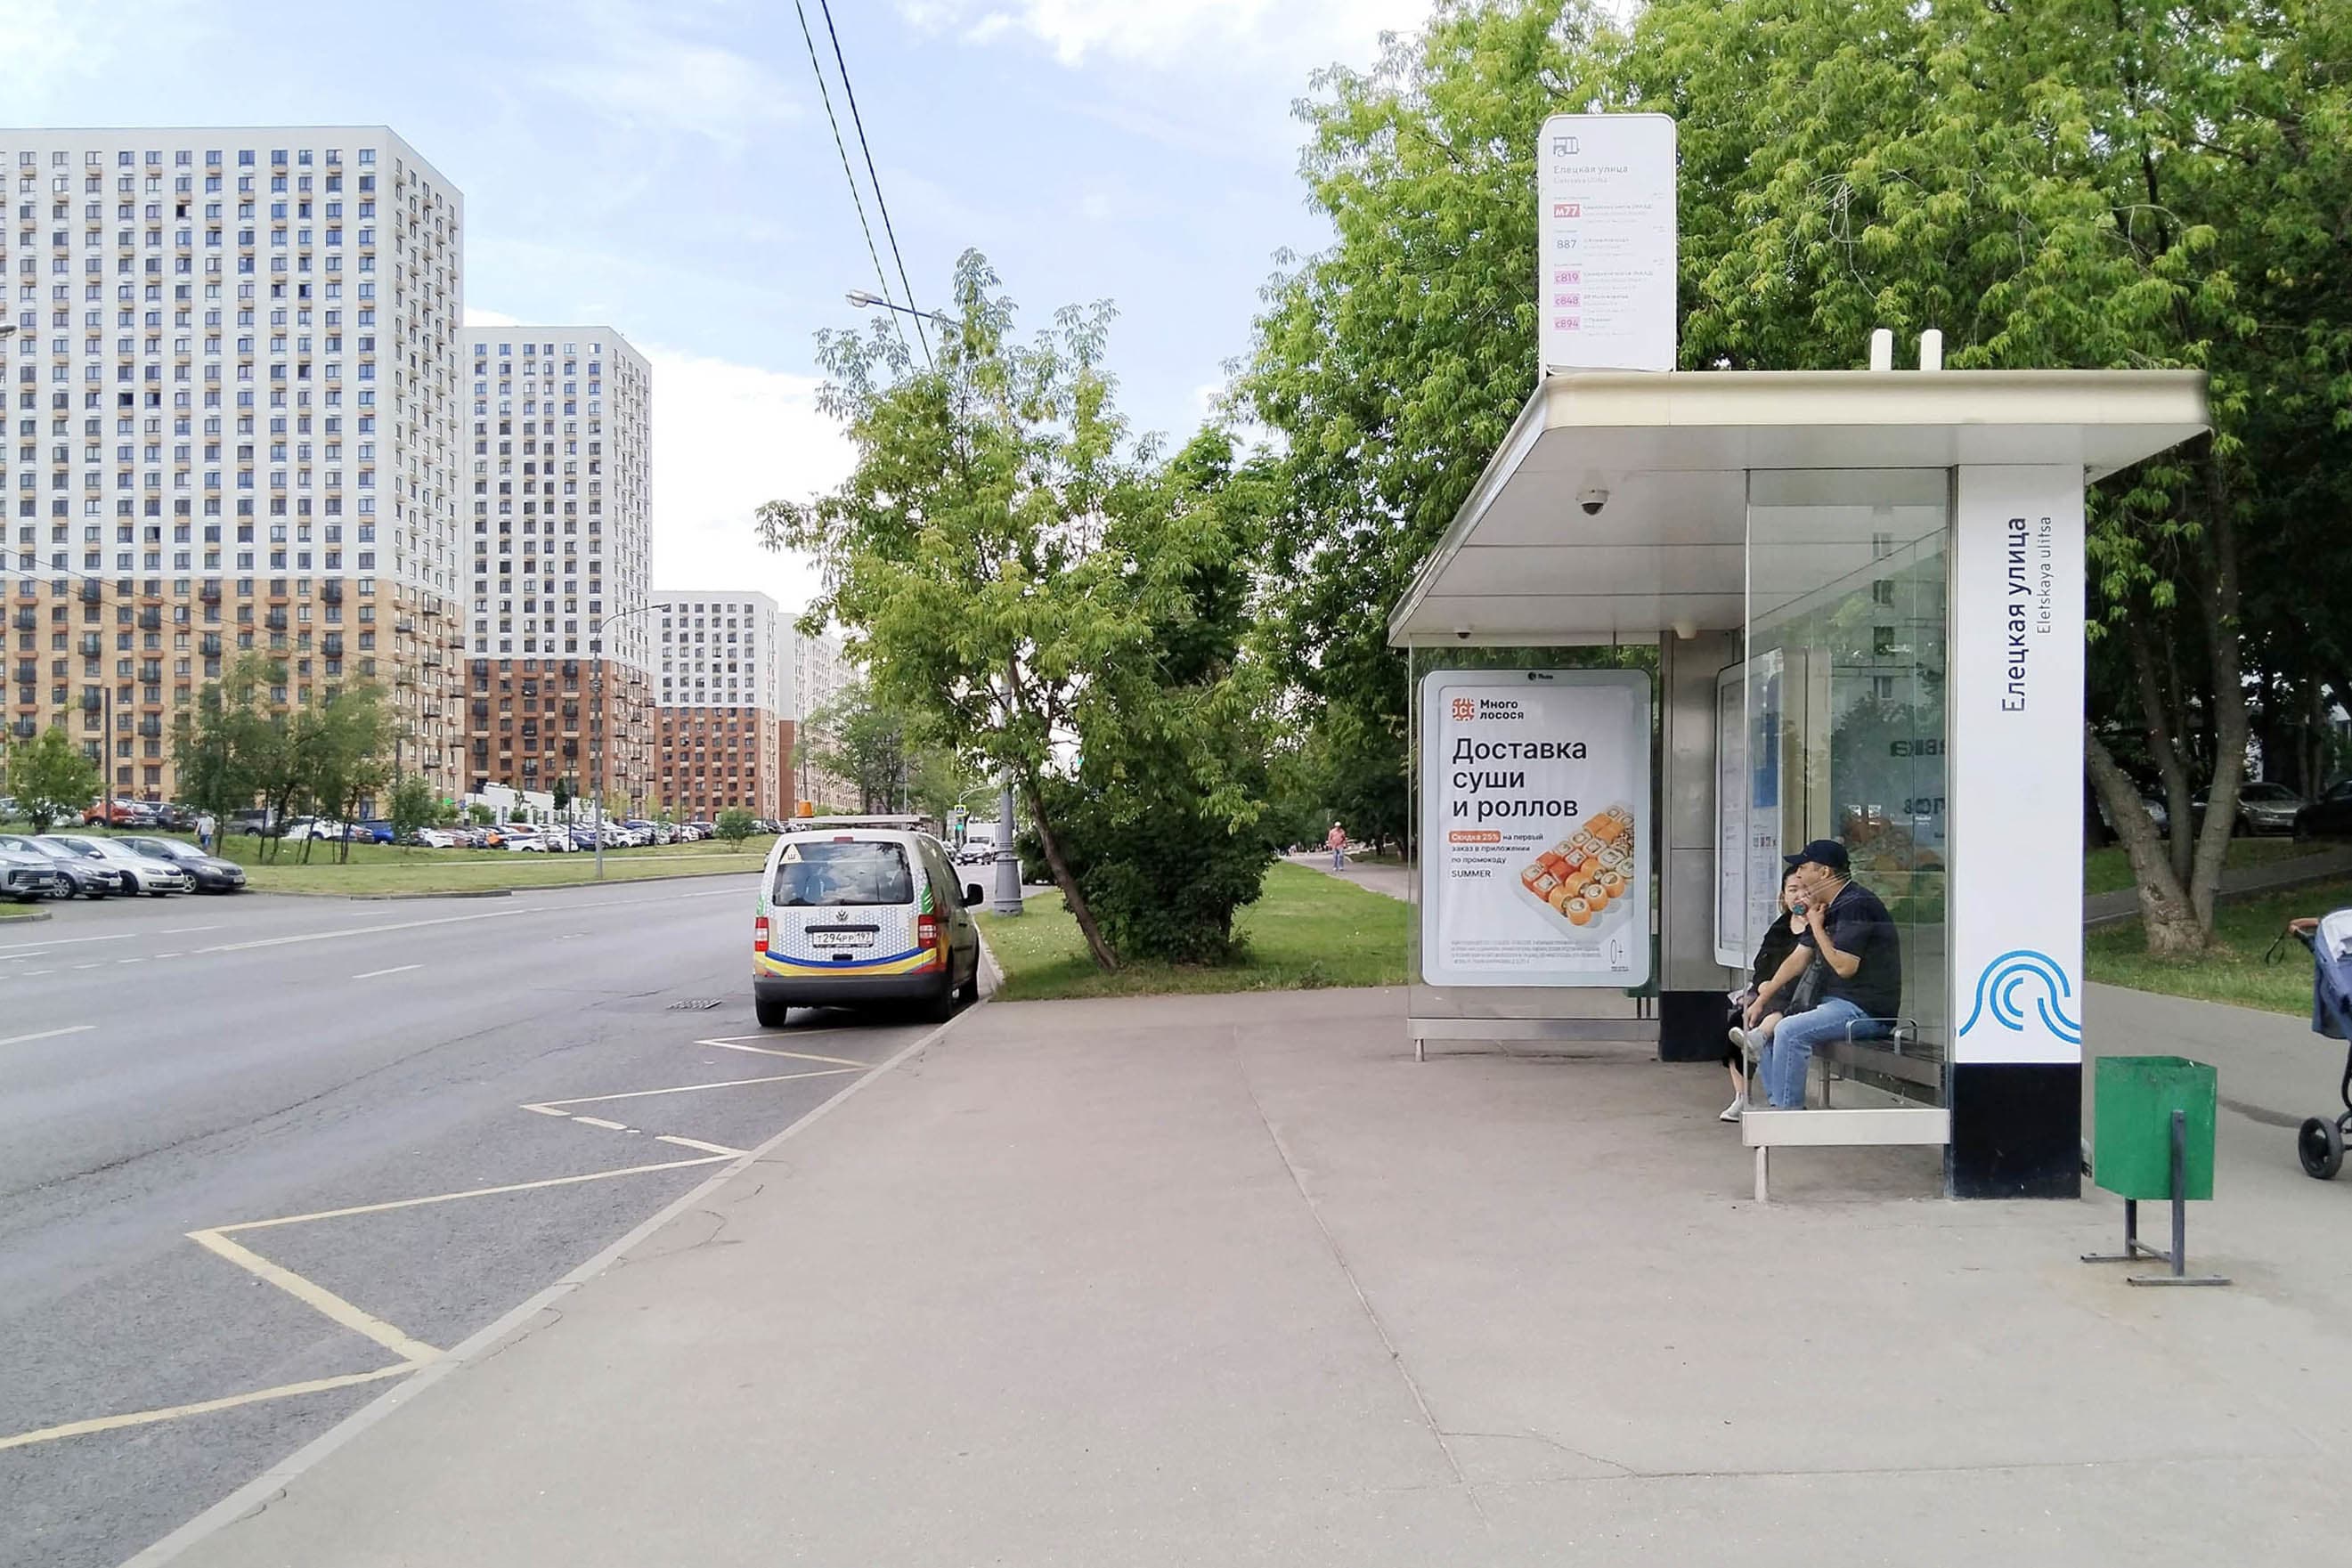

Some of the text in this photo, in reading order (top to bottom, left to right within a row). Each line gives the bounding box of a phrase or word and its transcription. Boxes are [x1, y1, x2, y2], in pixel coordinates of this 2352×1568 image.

[1599, 165, 1629, 175] улица
[1557, 239, 1576, 249] 887
[2036, 516, 2054, 634] Eletskaya ulitsa
[2001, 517, 2031, 712] Елецкая улица
[1480, 699, 1518, 710] Много
[1480, 711, 1525, 720] лосося
[1453, 738, 1587, 765] Доставка
[1453, 771, 1525, 793] суши
[1453, 800, 1579, 823] и роллов
[1452, 833, 1480, 841] Скидка
[1514, 833, 1544, 841] первый
[1481, 846, 1530, 854] приложении
[1452, 870, 1491, 878] SUMMER
